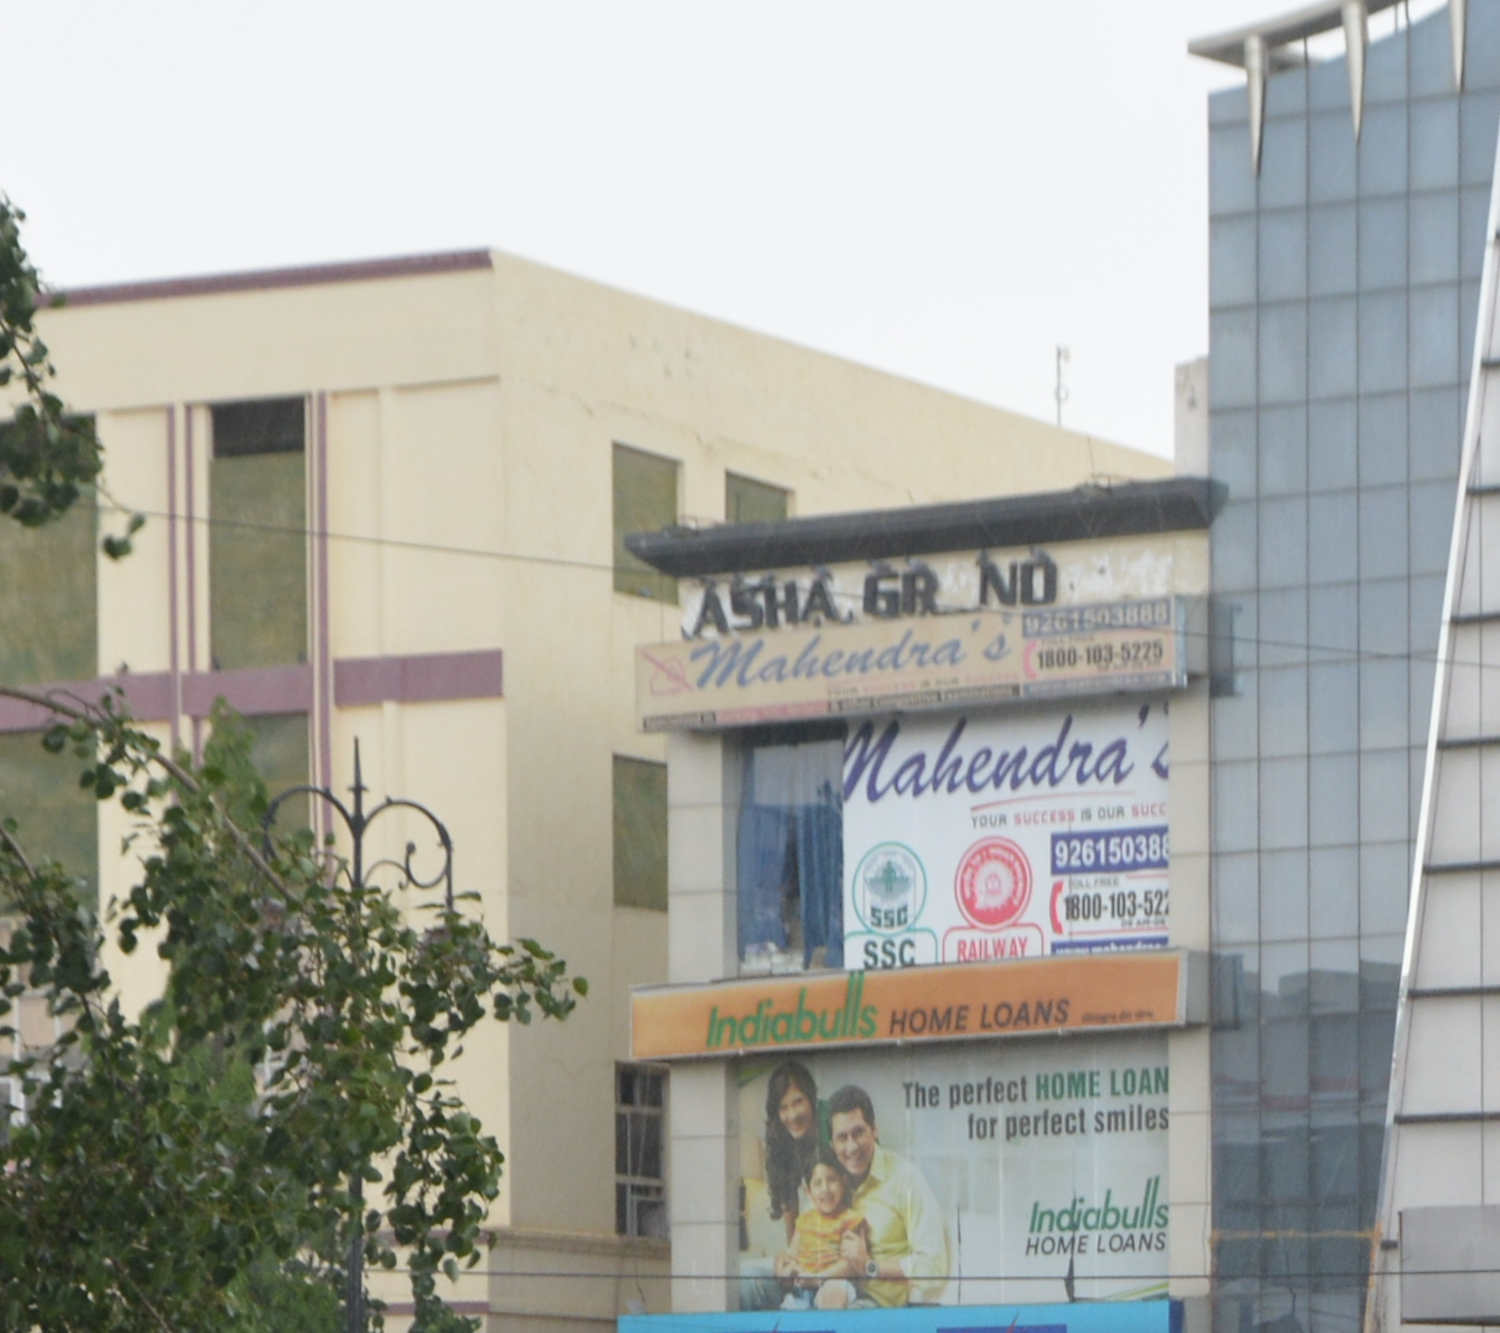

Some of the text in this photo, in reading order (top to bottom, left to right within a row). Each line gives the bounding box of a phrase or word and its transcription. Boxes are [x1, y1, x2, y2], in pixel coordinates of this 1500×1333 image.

[686, 568, 840, 637] ASHA
[690, 620, 1012, 690] Mahendra's
[1038, 639, 1163, 669] 1800-103-5225
[972, 813, 1008, 829] YOUR
[1014, 808, 1076, 826] SUCCESS
[1081, 806, 1092, 822] IS
[1098, 805, 1126, 821] OUR
[1095, 876, 1120, 887] FREE
[863, 940, 916, 969] SSC
[958, 937, 1028, 963] RAILWAY
[706, 970, 879, 1047] Indiabulls
[890, 1006, 969, 1035] HOME
[980, 999, 1070, 1030] LOANS
[903, 1067, 1169, 1110] The perfect HOME LOAN
[968, 1104, 1169, 1141] for perfect smiles
[1029, 1175, 1169, 1234] Indiabulls
[1026, 1232, 1167, 1256] HOME LOANS
